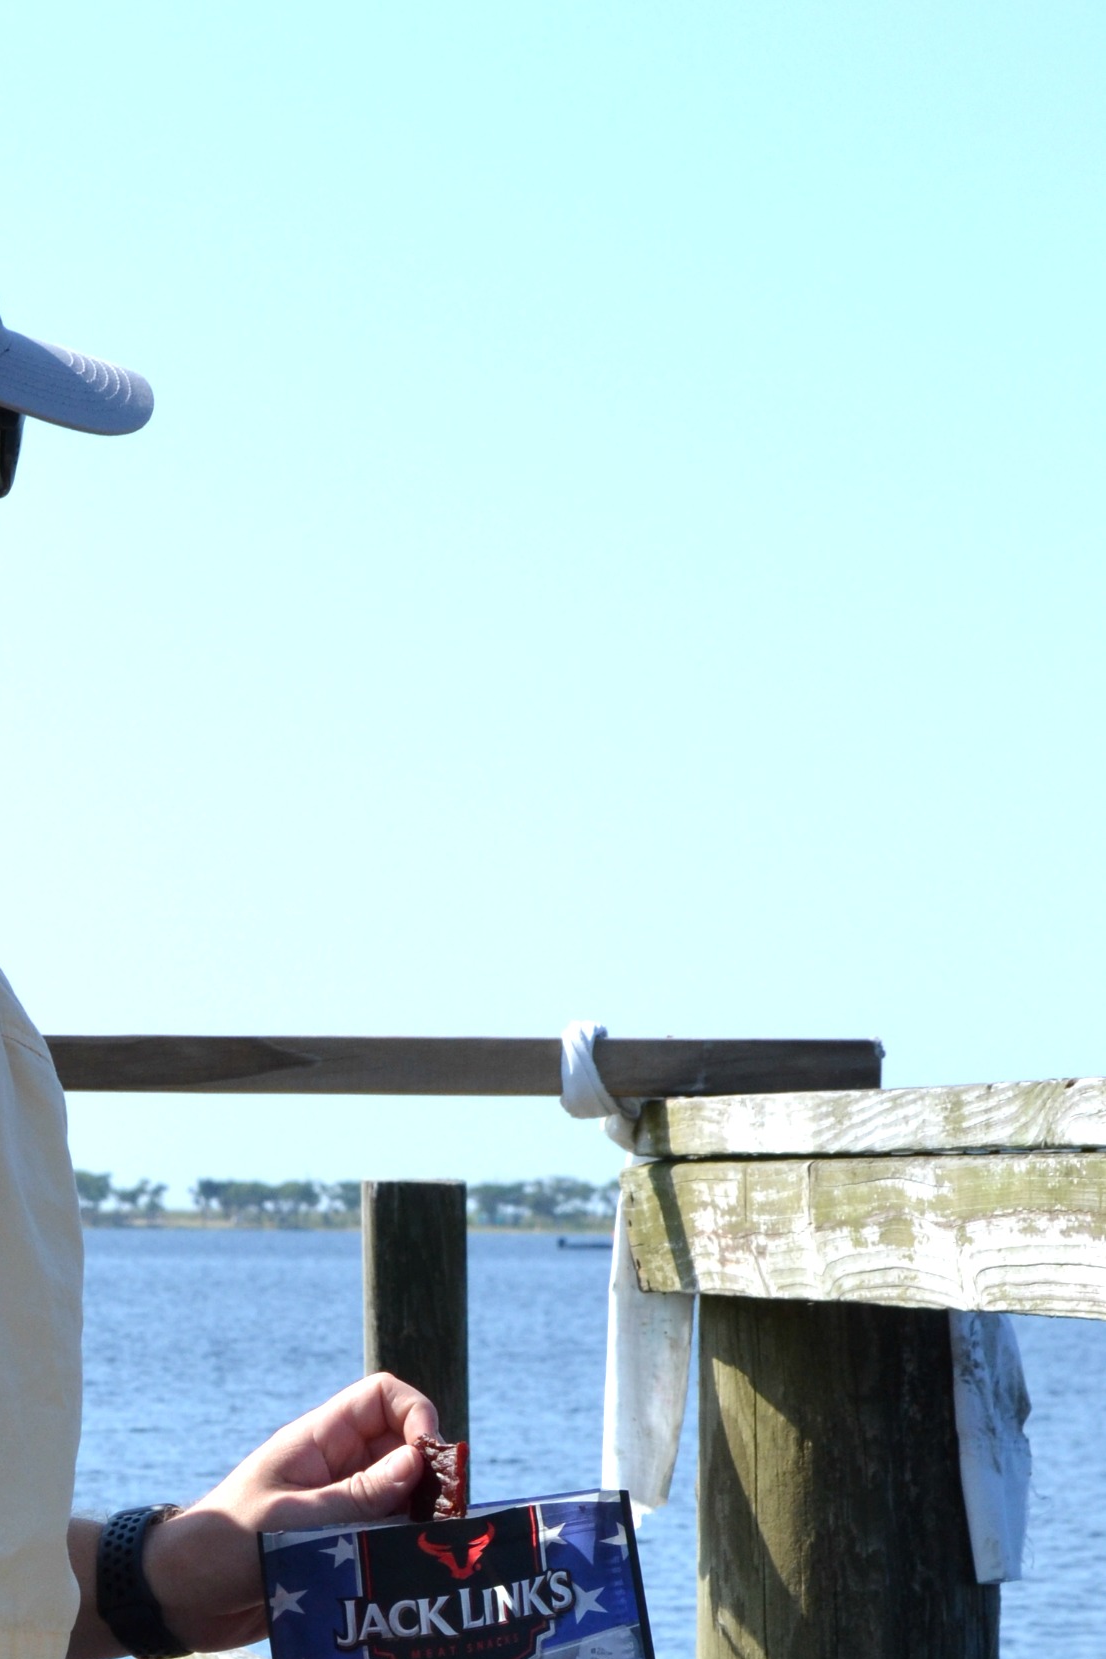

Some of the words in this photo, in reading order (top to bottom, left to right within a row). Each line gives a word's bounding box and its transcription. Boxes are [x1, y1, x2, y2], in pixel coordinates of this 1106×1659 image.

[336, 1595, 460, 1647] JACK
[458, 1570, 573, 1630] LINK'S
[410, 1645, 458, 1659] MEAT
[466, 1634, 520, 1653] SNACKS
